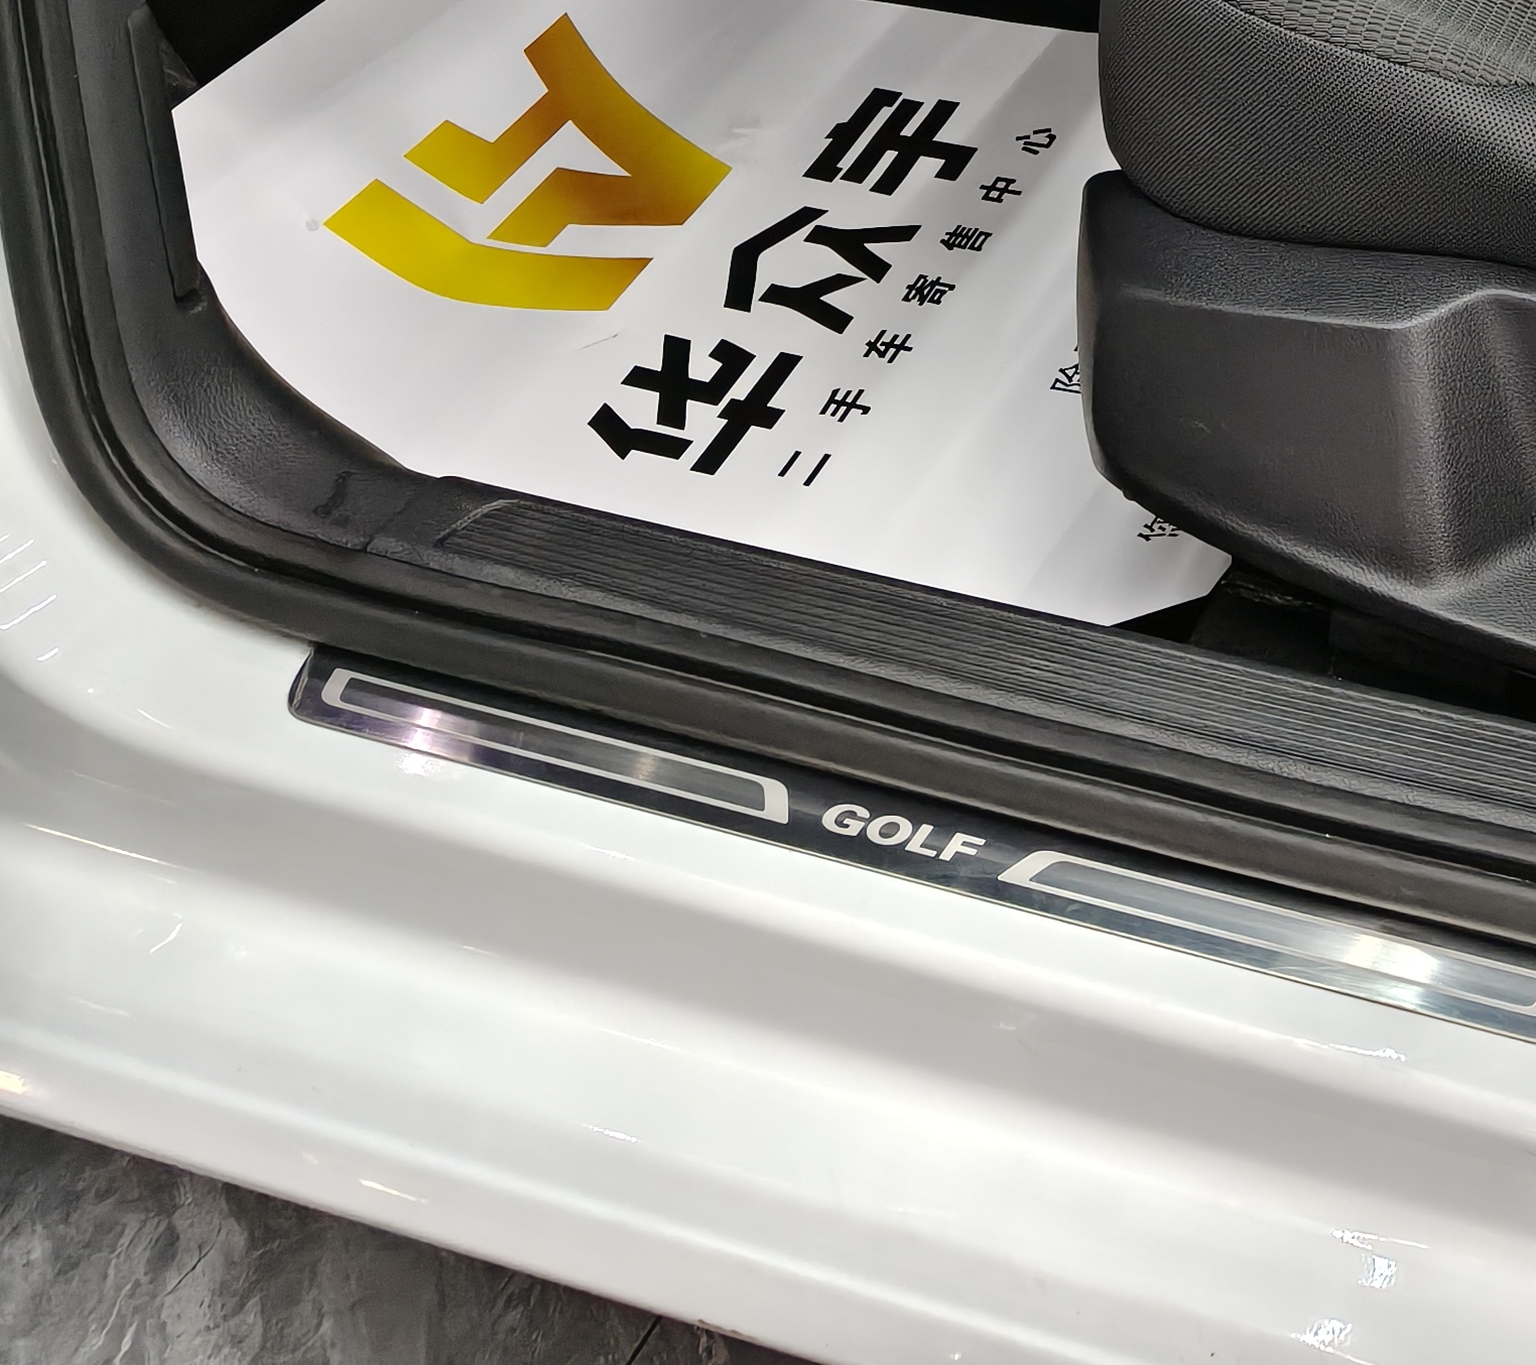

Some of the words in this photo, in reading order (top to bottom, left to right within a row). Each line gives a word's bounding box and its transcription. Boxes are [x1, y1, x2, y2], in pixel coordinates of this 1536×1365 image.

[586, 87, 979, 477] 华众宇
[777, 126, 1057, 488] 二手车寄售中心
[821, 803, 987, 862] GOLF
